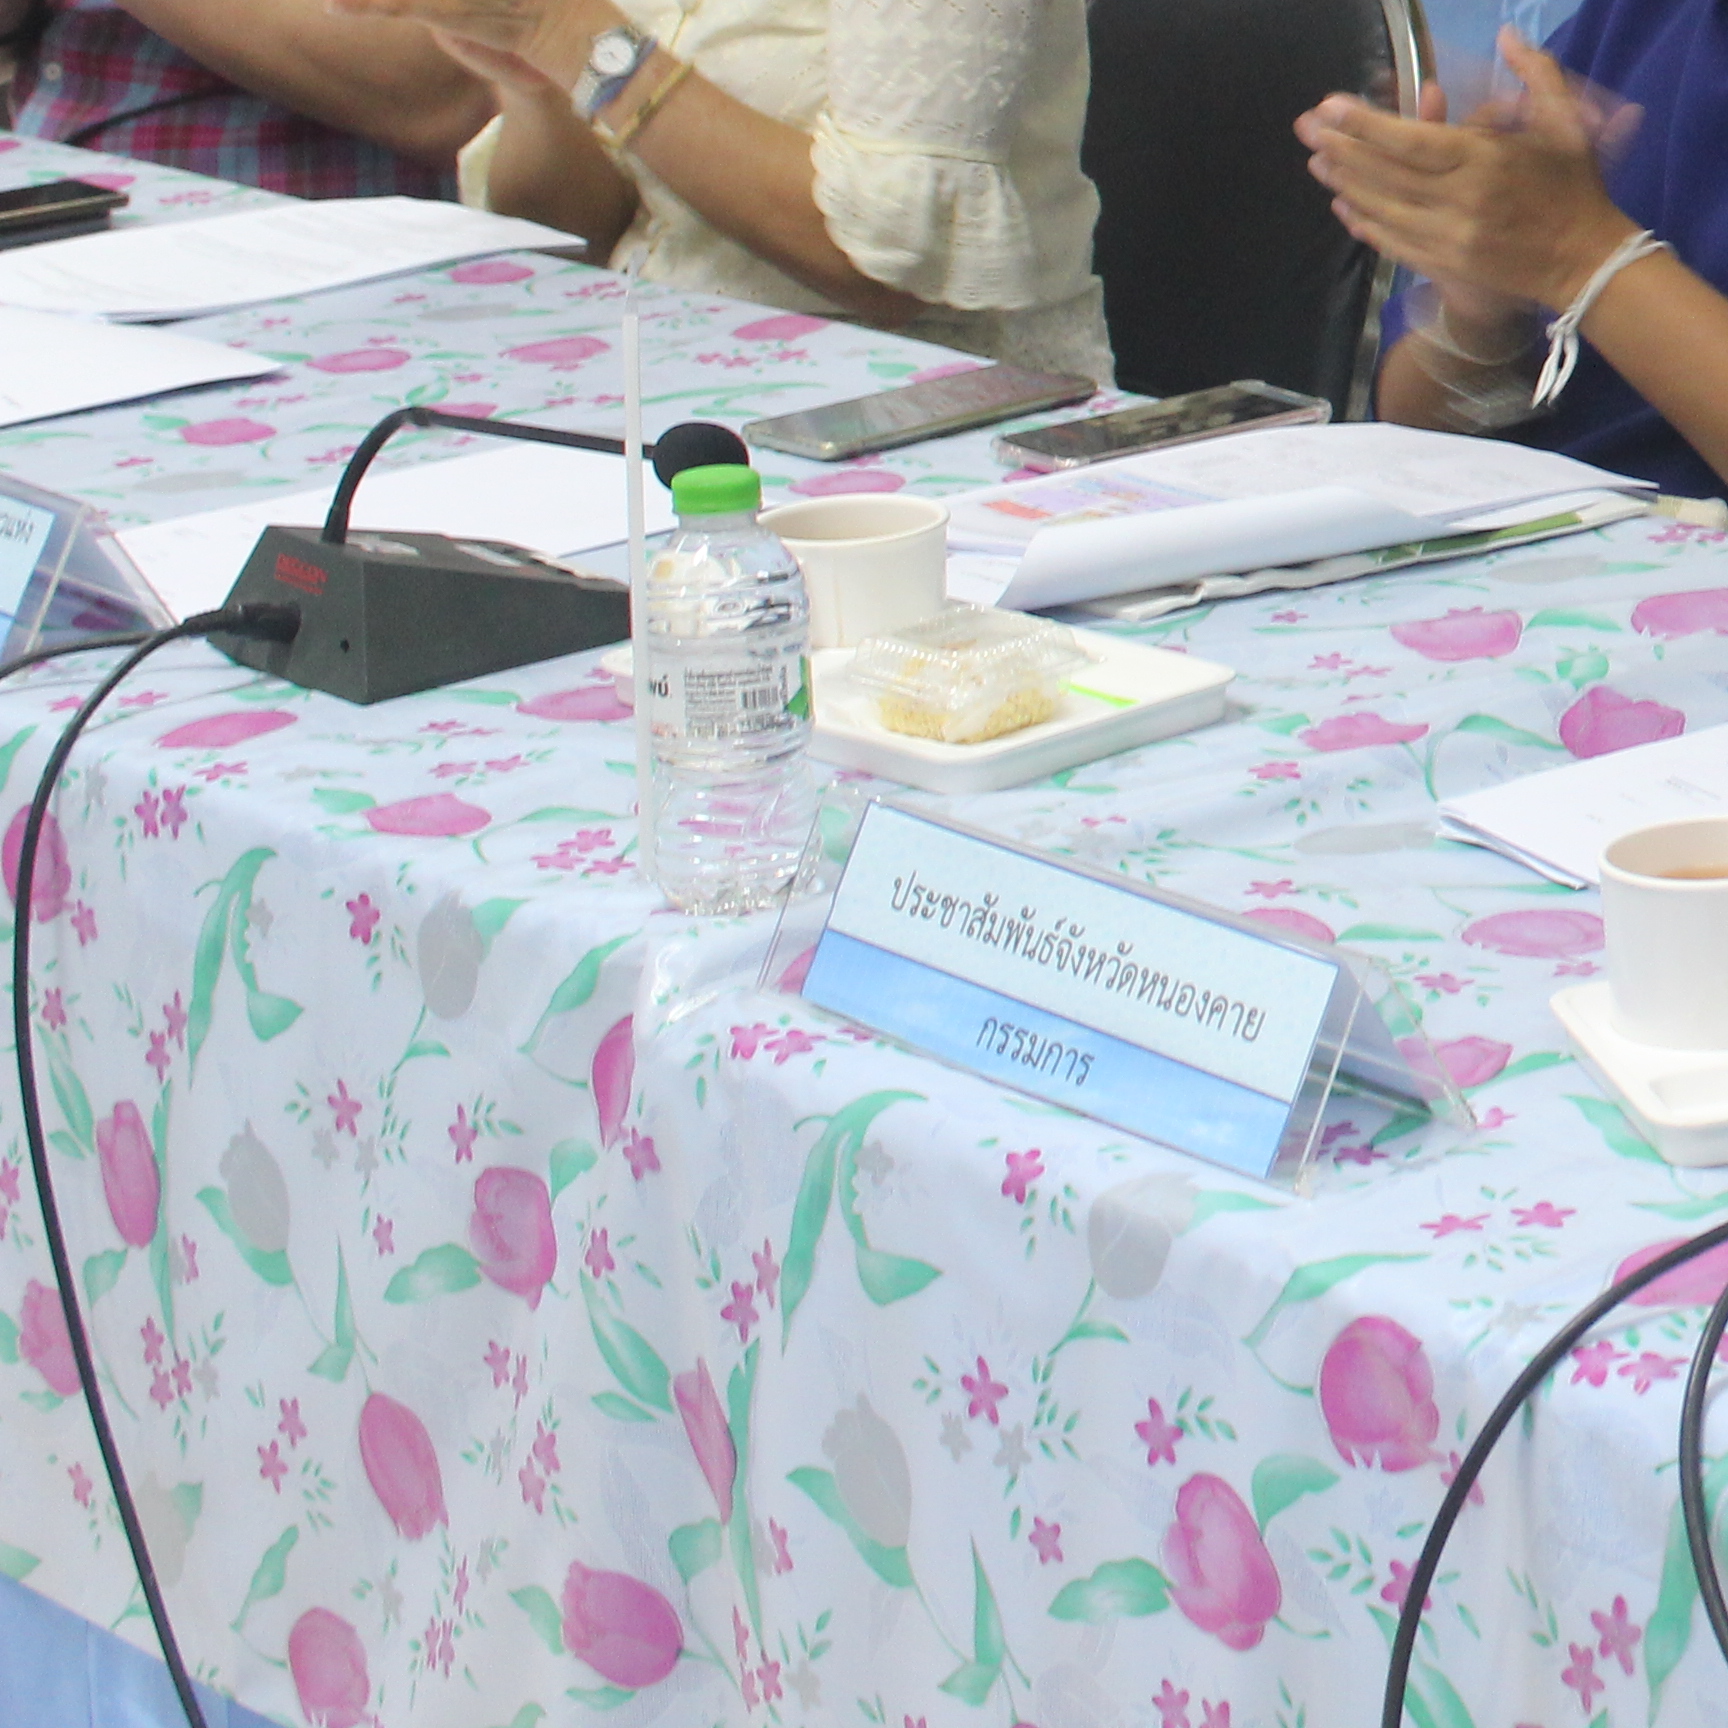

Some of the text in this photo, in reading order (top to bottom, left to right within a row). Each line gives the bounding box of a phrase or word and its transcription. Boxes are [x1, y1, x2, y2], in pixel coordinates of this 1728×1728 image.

[890, 869, 1266, 1043] ประชาสัมพันธ์จังหวัดหนองคาย
[976, 1016, 1096, 1087] กรรมการ
